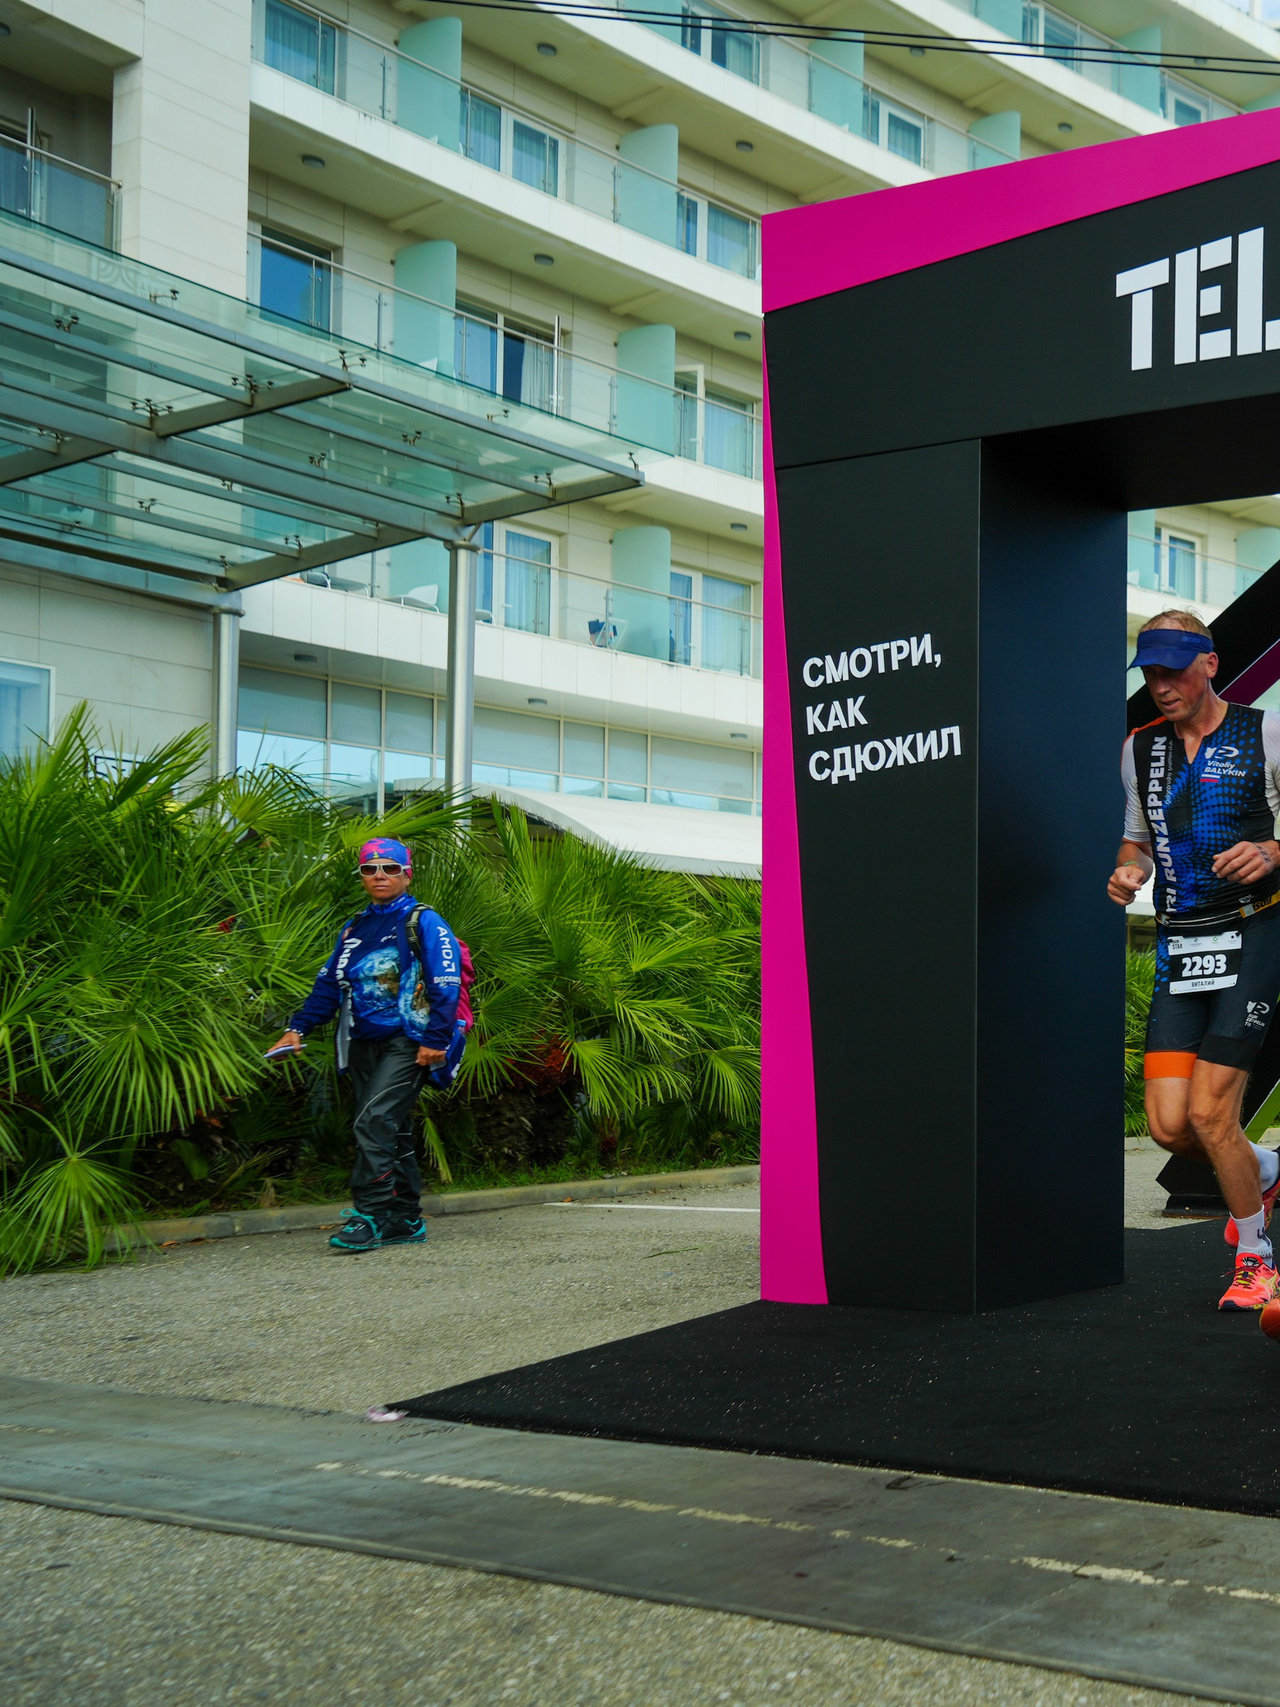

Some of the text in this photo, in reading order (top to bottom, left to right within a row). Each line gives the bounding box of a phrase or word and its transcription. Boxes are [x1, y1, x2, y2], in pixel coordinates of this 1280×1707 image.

[802, 633, 942, 688] СМОТРИ,
[806, 695, 869, 736] КАК
[808, 725, 962, 785] СДЮЖИЛ
[1204, 766, 1246, 777] BALYKIN
[436, 926, 454, 960] AMD
[1181, 953, 1227, 978] 2293
[1191, 978, 1215, 988] ВИТАЛИЙ
